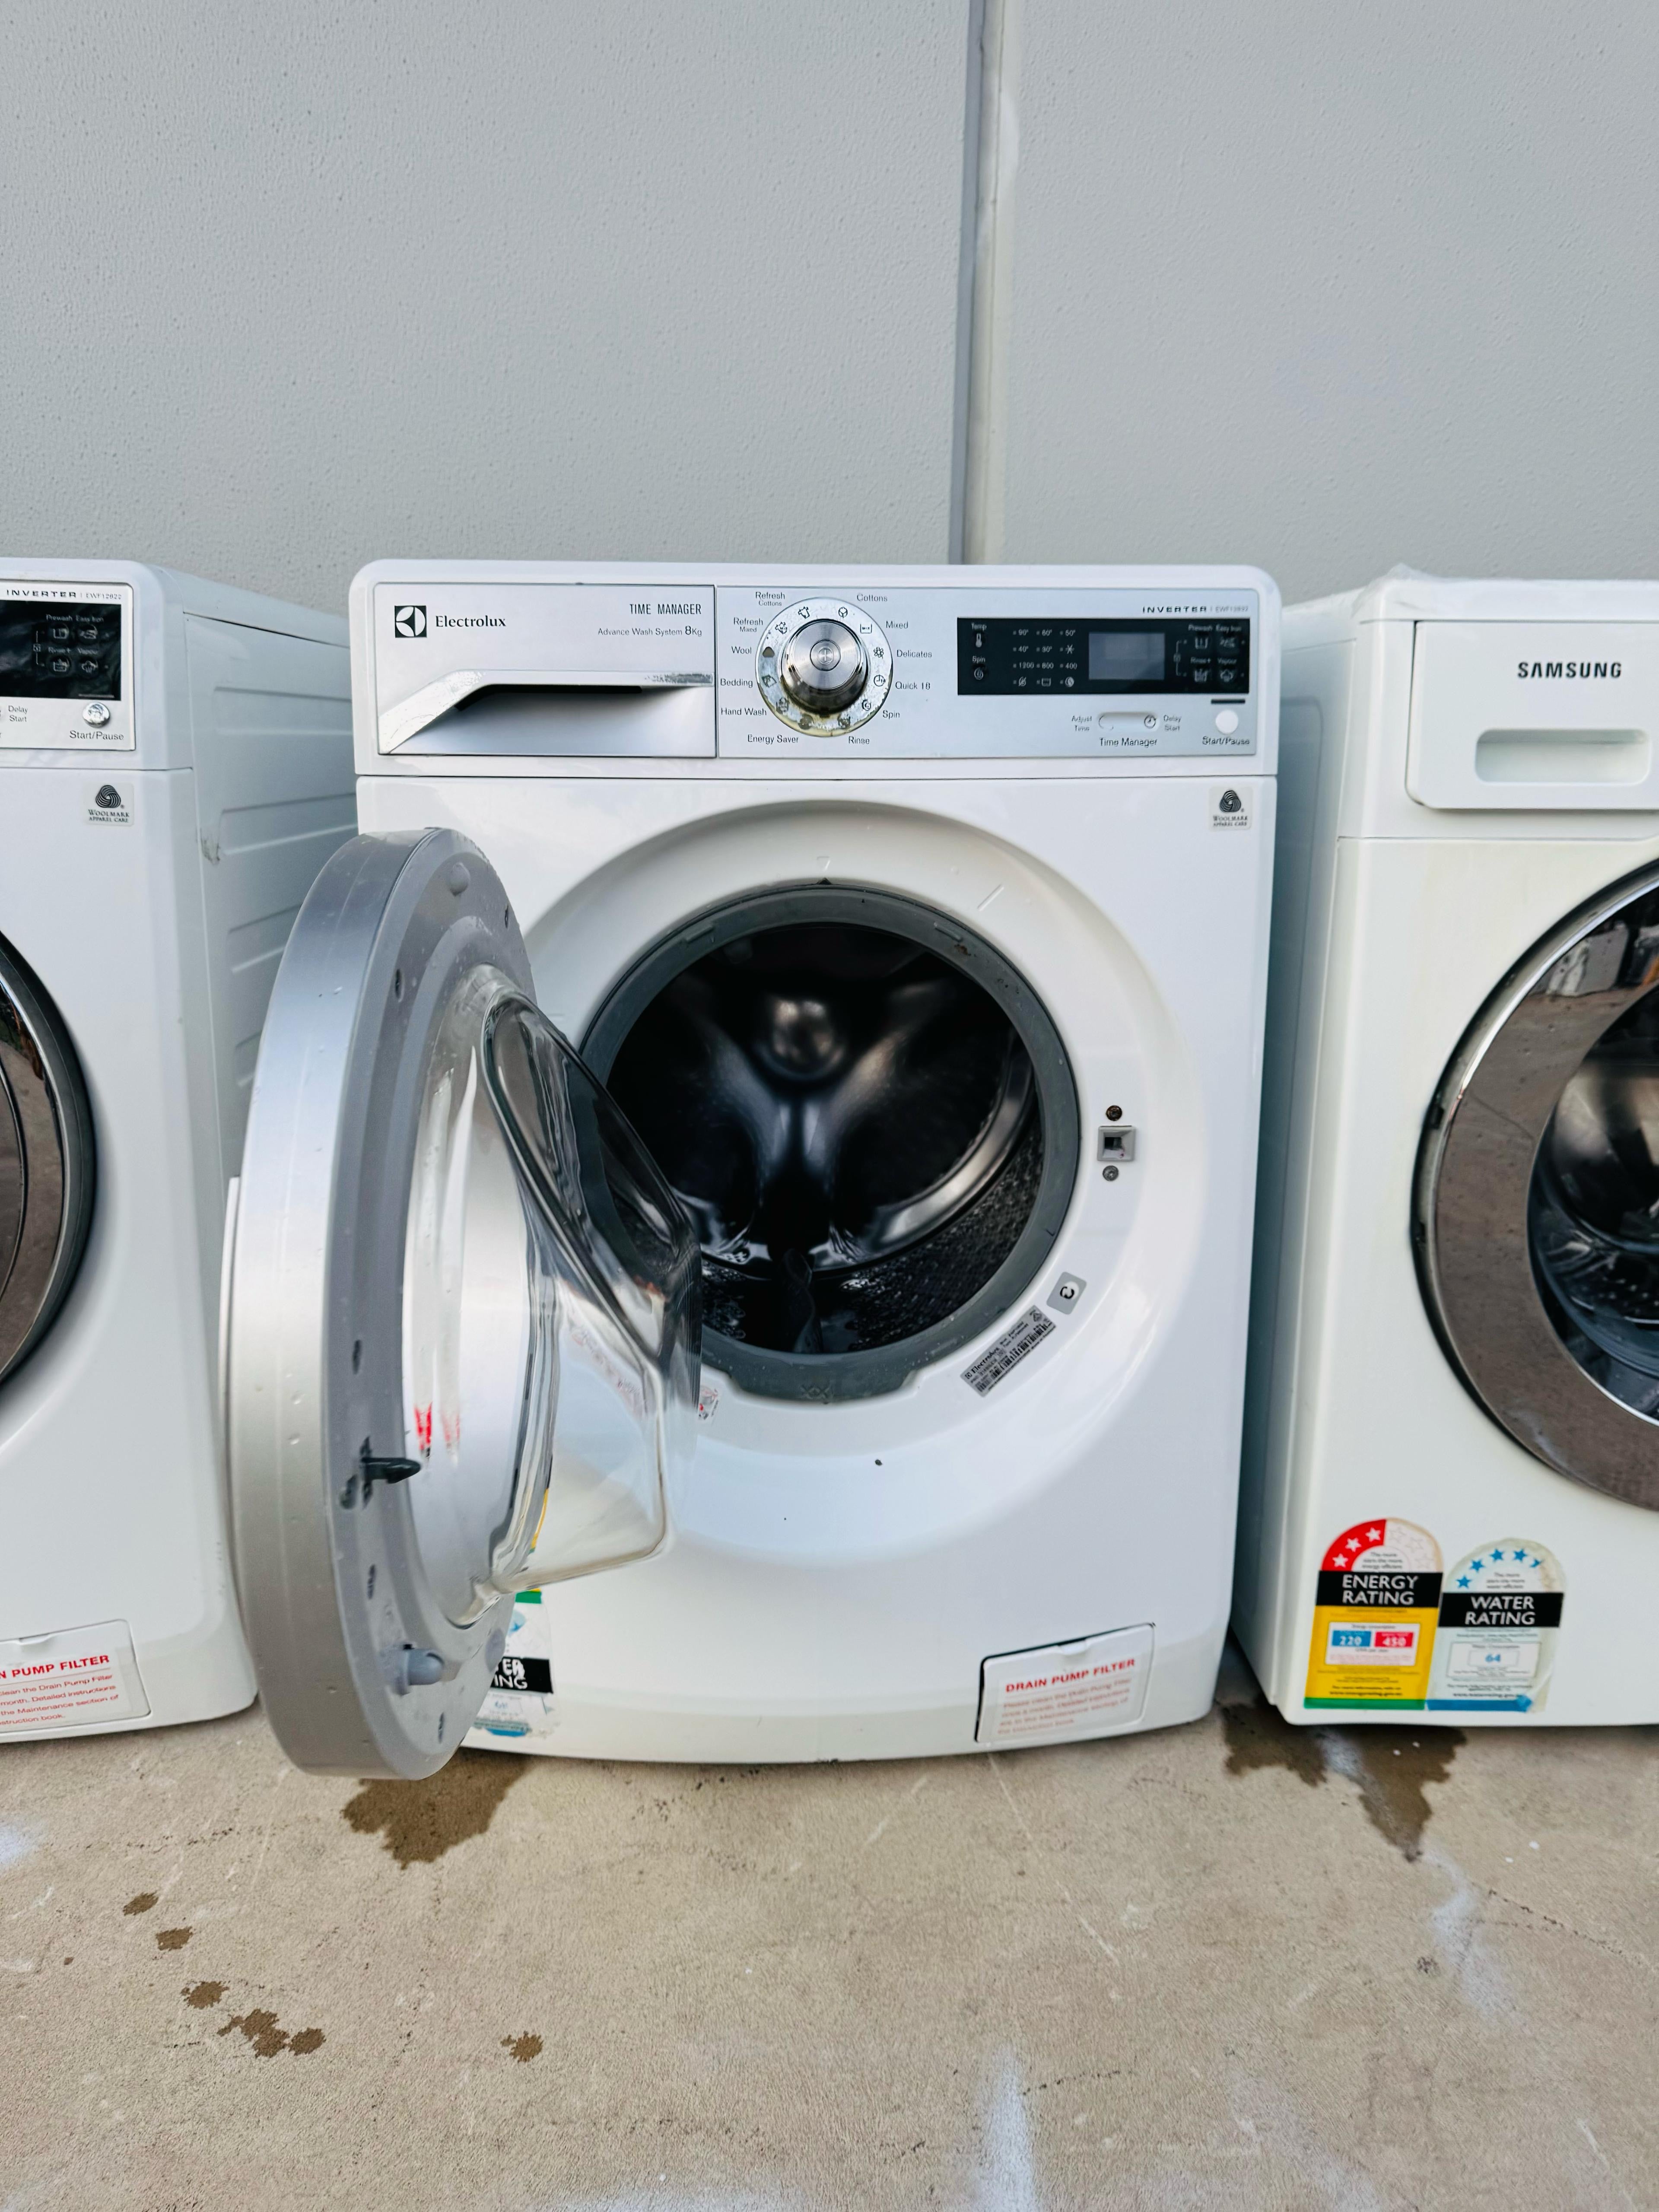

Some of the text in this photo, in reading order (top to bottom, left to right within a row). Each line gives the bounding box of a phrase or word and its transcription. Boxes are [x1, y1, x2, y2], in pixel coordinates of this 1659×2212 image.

[857, 593, 888, 602] Cottons
[629, 604, 702, 614] TIME MANAGER
[435, 615, 506, 628] Electrolux
[734, 617, 763, 625] Refresh
[655, 628, 682, 637] System
[971, 623, 987, 632] Temp
[897, 649, 932, 658] Delicates
[972, 655, 985, 664] Spin
[1517, 661, 1622, 678] SAMSUNG
[720, 678, 753, 688] Bedding
[895, 681, 918, 690] Quick
[8, 705, 28, 714] Delay
[721, 708, 767, 716] Hand Wash
[883, 710, 900, 719] Spin
[70, 730, 124, 741] Start/Pause
[747, 734, 799, 745] Energy Saver
[848, 736, 870, 745] Rinse
[1202, 735, 1250, 746] Start/Pause
[1099, 737, 1158, 748] Time Manager
[88, 809, 130, 817] WOOLMARK
[1342, 1574, 1419, 1590] ENERGY
[1342, 1590, 1415, 1605] RATING
[1471, 1595, 1535, 1610] WATER
[1465, 1611, 1536, 1625] RATING
[1485, 1654, 1501, 1662] 64
[12, 1664, 54, 1678] PUMP
[60, 1655, 110, 1670] FILTER
[1005, 1659, 1135, 1693] DRAIN PUMP FILTER
[64, 1678, 90, 1688] Pump
[495, 1674, 528, 1689] ING
[32, 1692, 66, 1702] Detailed
[68, 1685, 116, 1697] instructions
[18, 1702, 74, 1714] Maintenance
[76, 1697, 108, 1706] section
[0, 1716, 39, 1726] struction
